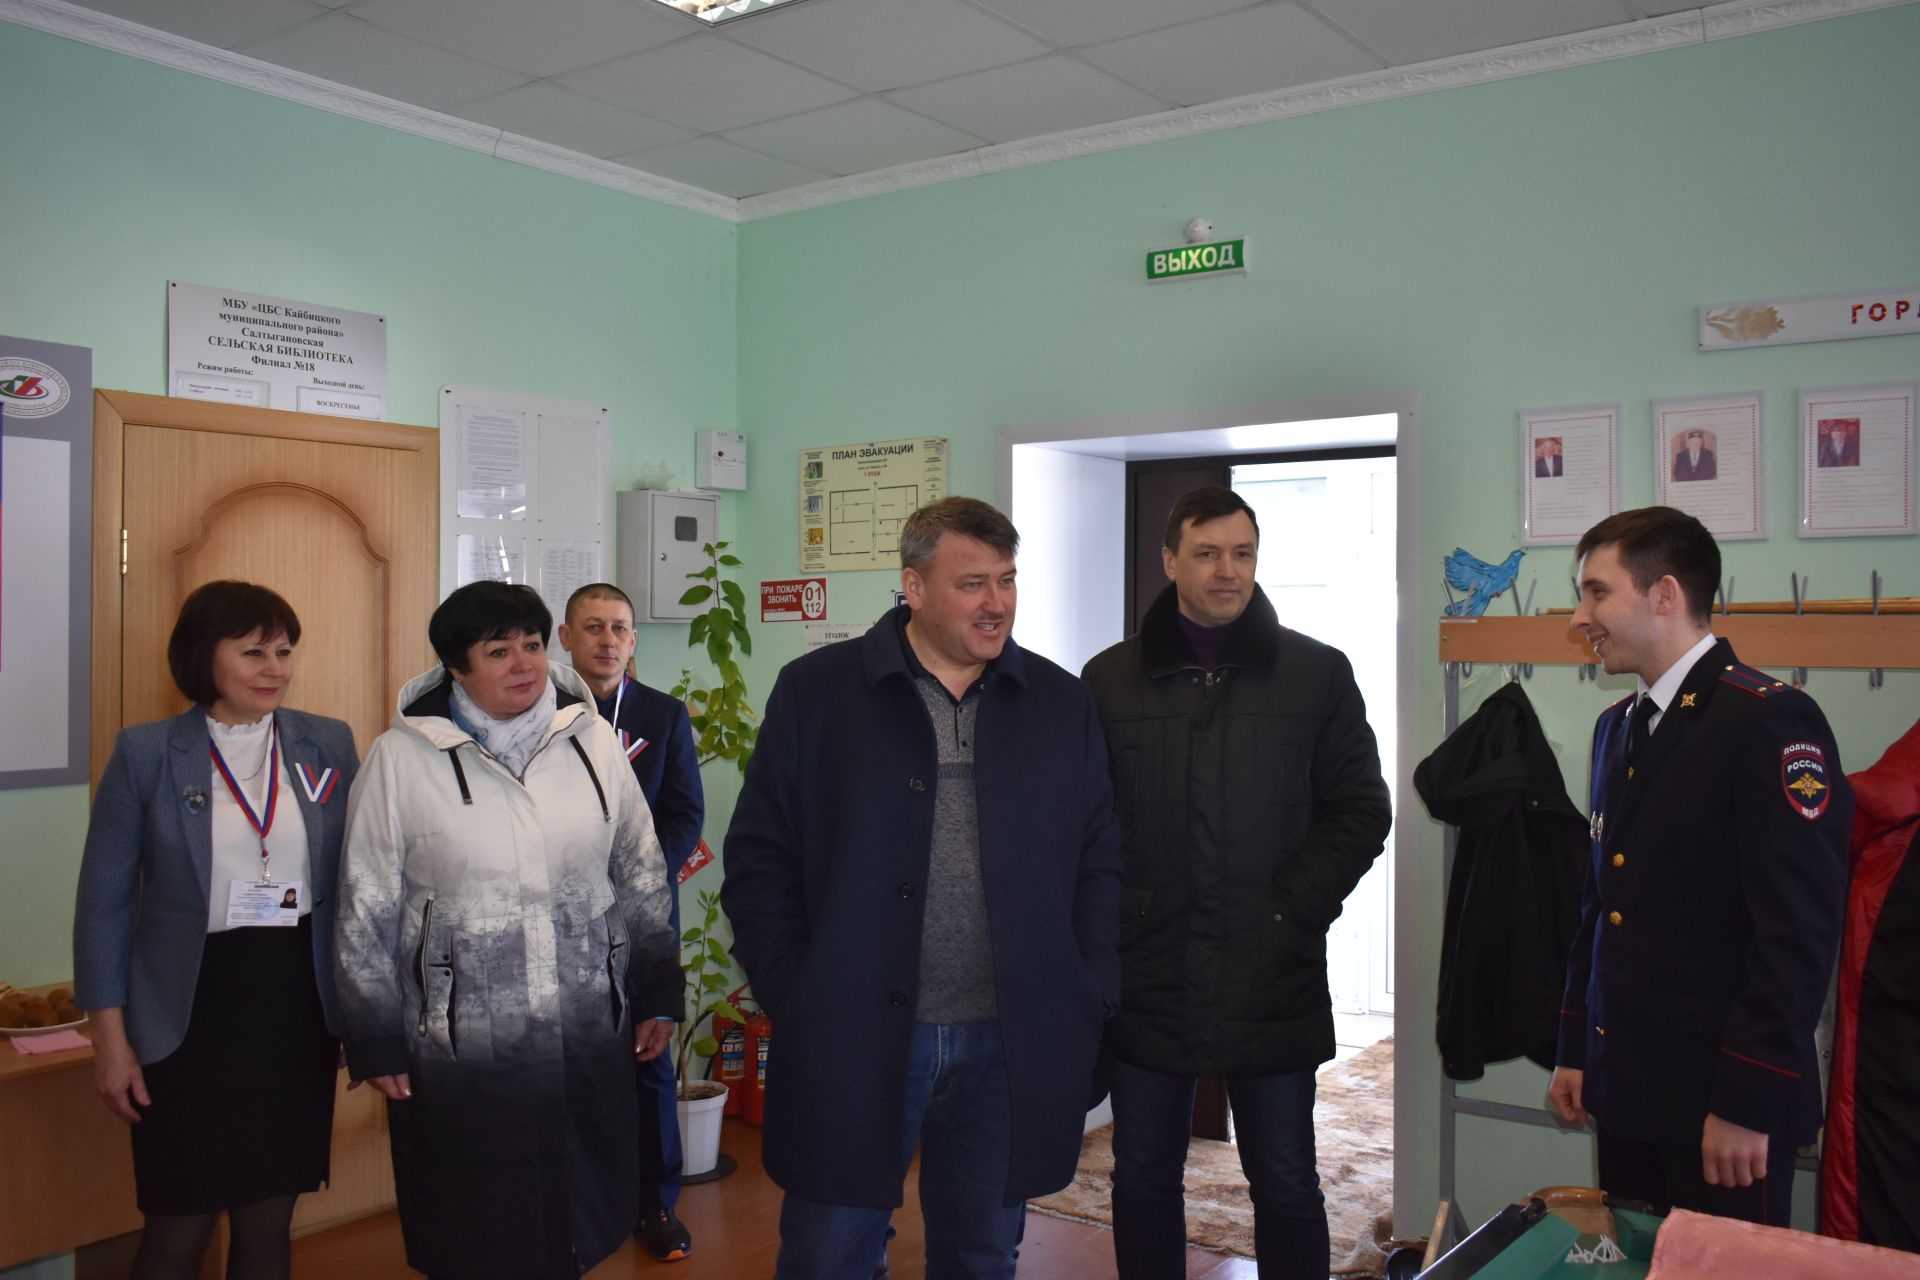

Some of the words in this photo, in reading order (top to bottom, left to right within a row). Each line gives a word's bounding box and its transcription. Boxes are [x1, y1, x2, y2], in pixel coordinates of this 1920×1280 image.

[1153, 244, 1236, 275] ВЫХОД
[222, 297, 249, 310] МБУ
[251, 302, 282, 316] «ЦБС
[284, 305, 341, 325] Кайбицкого
[1851, 300, 1920, 325] ГОР
[219, 311, 303, 332] муниципального
[305, 322, 344, 338] района»
[241, 327, 324, 348] Салтыгановская
[208, 335, 274, 353] СЕЛЬСКАЯ
[276, 344, 354, 365] БИБЛИОТЕКА
[197, 362, 222, 373] Режим
[224, 365, 254, 376] работы:
[251, 355, 291, 369] Филиал
[293, 359, 315, 372] №18
[313, 377, 346, 389] Выходной
[832, 448, 857, 460] ПЛАН
[859, 444, 914, 458] ЭВАКУАЦИИ
[761, 585, 774, 594] ПРИ
[776, 584, 804, 594] ПОЖАРЕ
[805, 586, 822, 602] 01
[767, 594, 797, 604] ЗВОНИТЬ
[804, 602, 821, 613] 112
[1783, 743, 1822, 756] ПОЛИЦИЯ
[1787, 759, 1824, 774] РОССИЯ
[1801, 806, 1819, 819] МВД
